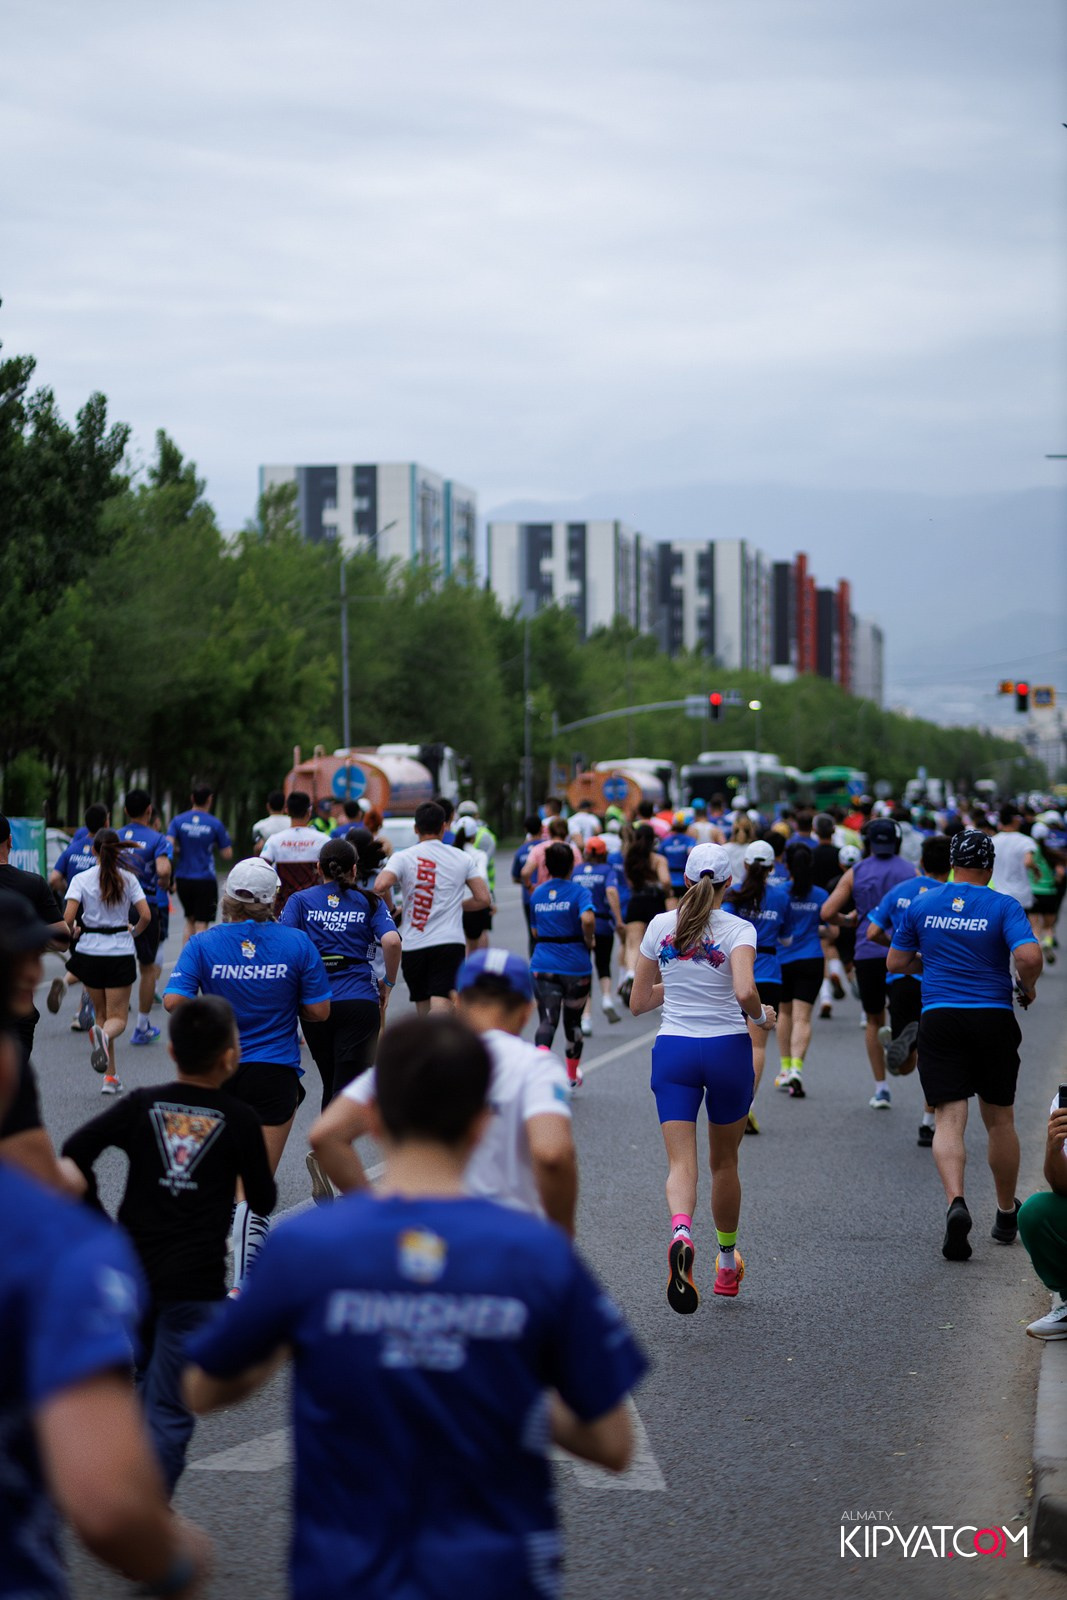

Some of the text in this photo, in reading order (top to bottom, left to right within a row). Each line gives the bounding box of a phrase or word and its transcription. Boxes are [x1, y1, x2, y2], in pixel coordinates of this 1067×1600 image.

[535, 901, 571, 912] FINISHER
[307, 910, 365, 923] FINISHER
[924, 915, 988, 931] FINISHER
[323, 922, 347, 931] 2025
[211, 963, 288, 979] FINISHER
[326, 1290, 528, 1339] FINISHER
